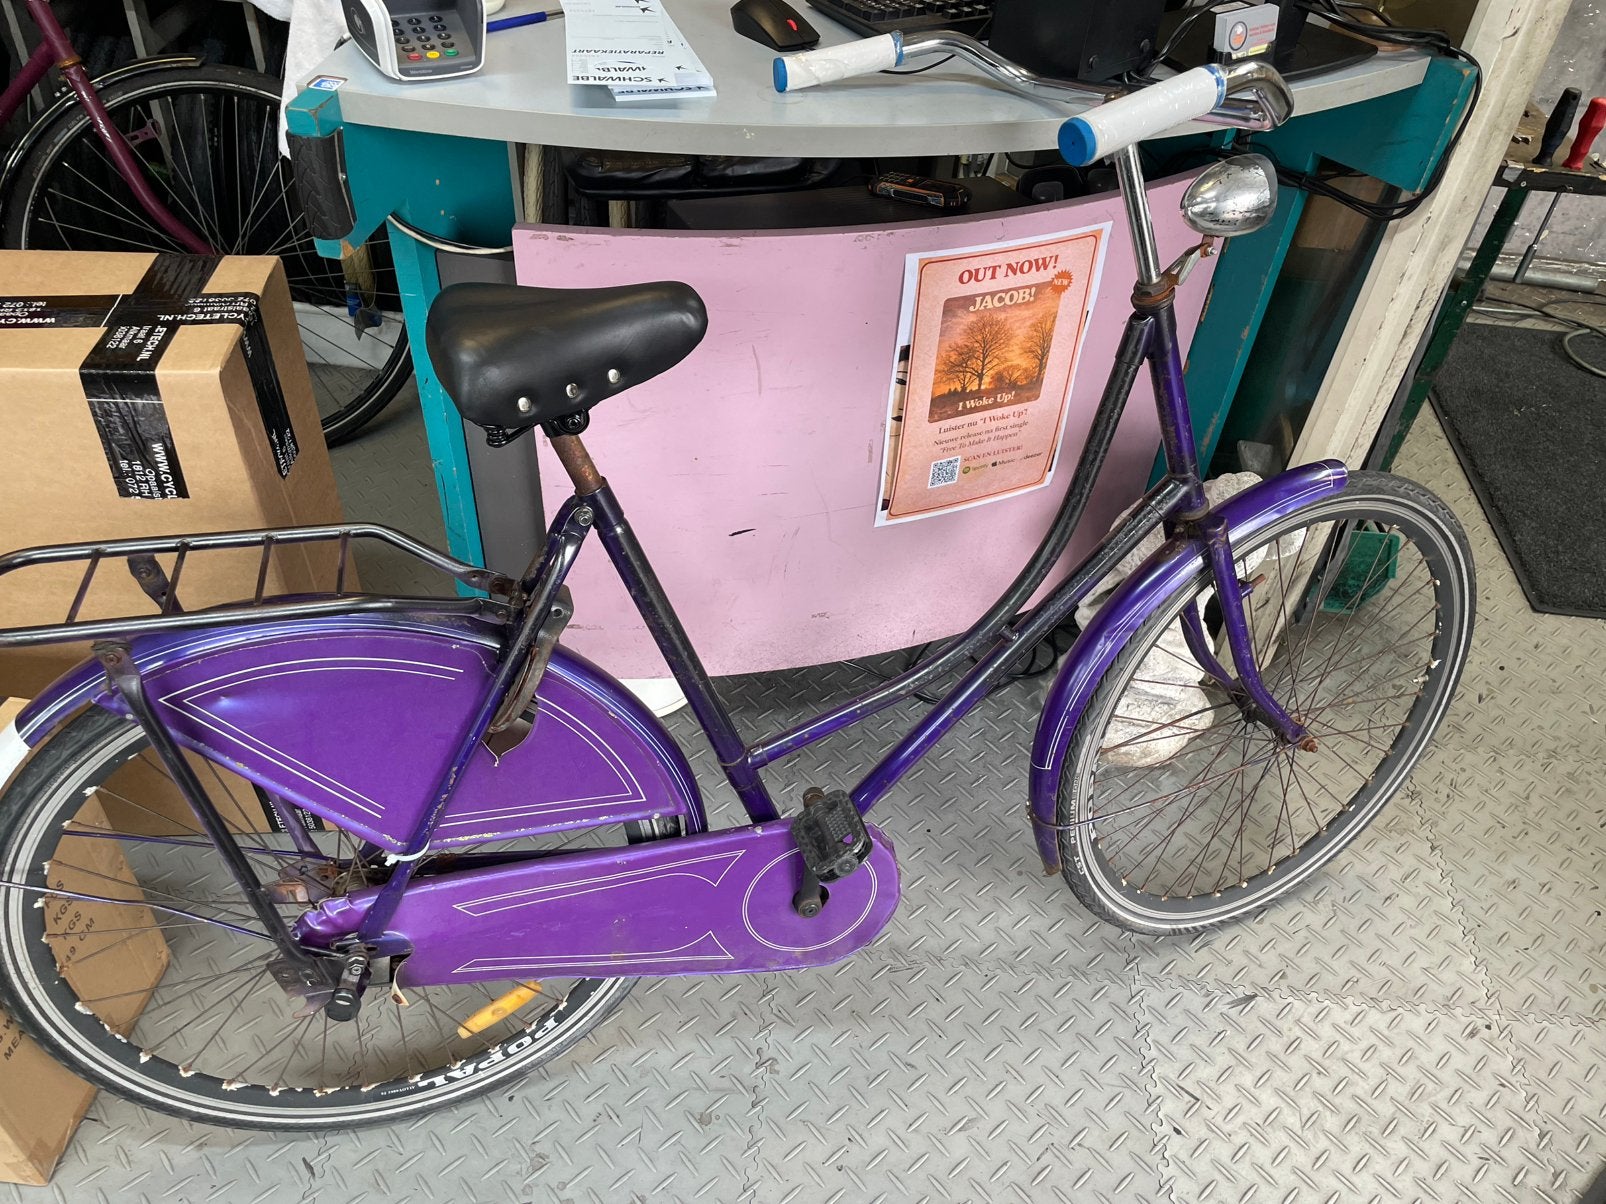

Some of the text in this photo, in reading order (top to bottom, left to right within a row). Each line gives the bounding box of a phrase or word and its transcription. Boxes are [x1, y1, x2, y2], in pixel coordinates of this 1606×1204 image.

[572, 75, 653, 83] SCHWALBE
[958, 254, 1059, 285] OUT NOW!
[1053, 278, 1070, 286] NEW
[969, 287, 1036, 312] JACOB!
[136, 325, 168, 361] ETECH.NL
[957, 390, 1016, 411] I Woke Up!
[933, 436, 959, 447] Nieuwe
[960, 430, 984, 441] release
[1009, 420, 1029, 432] single
[938, 422, 966, 435] Luister
[988, 413, 1011, 422] Woke
[958, 442, 968, 450] To
[968, 439, 987, 448] Make
[963, 453, 982, 463] SCAN
[131, 460, 147, 481] 1812
[151, 442, 178, 499] WWW.CYCL
[125, 477, 139, 494] 072
[1073, 855, 1085, 875] CST
[417, 1016, 559, 1087] POPAL
